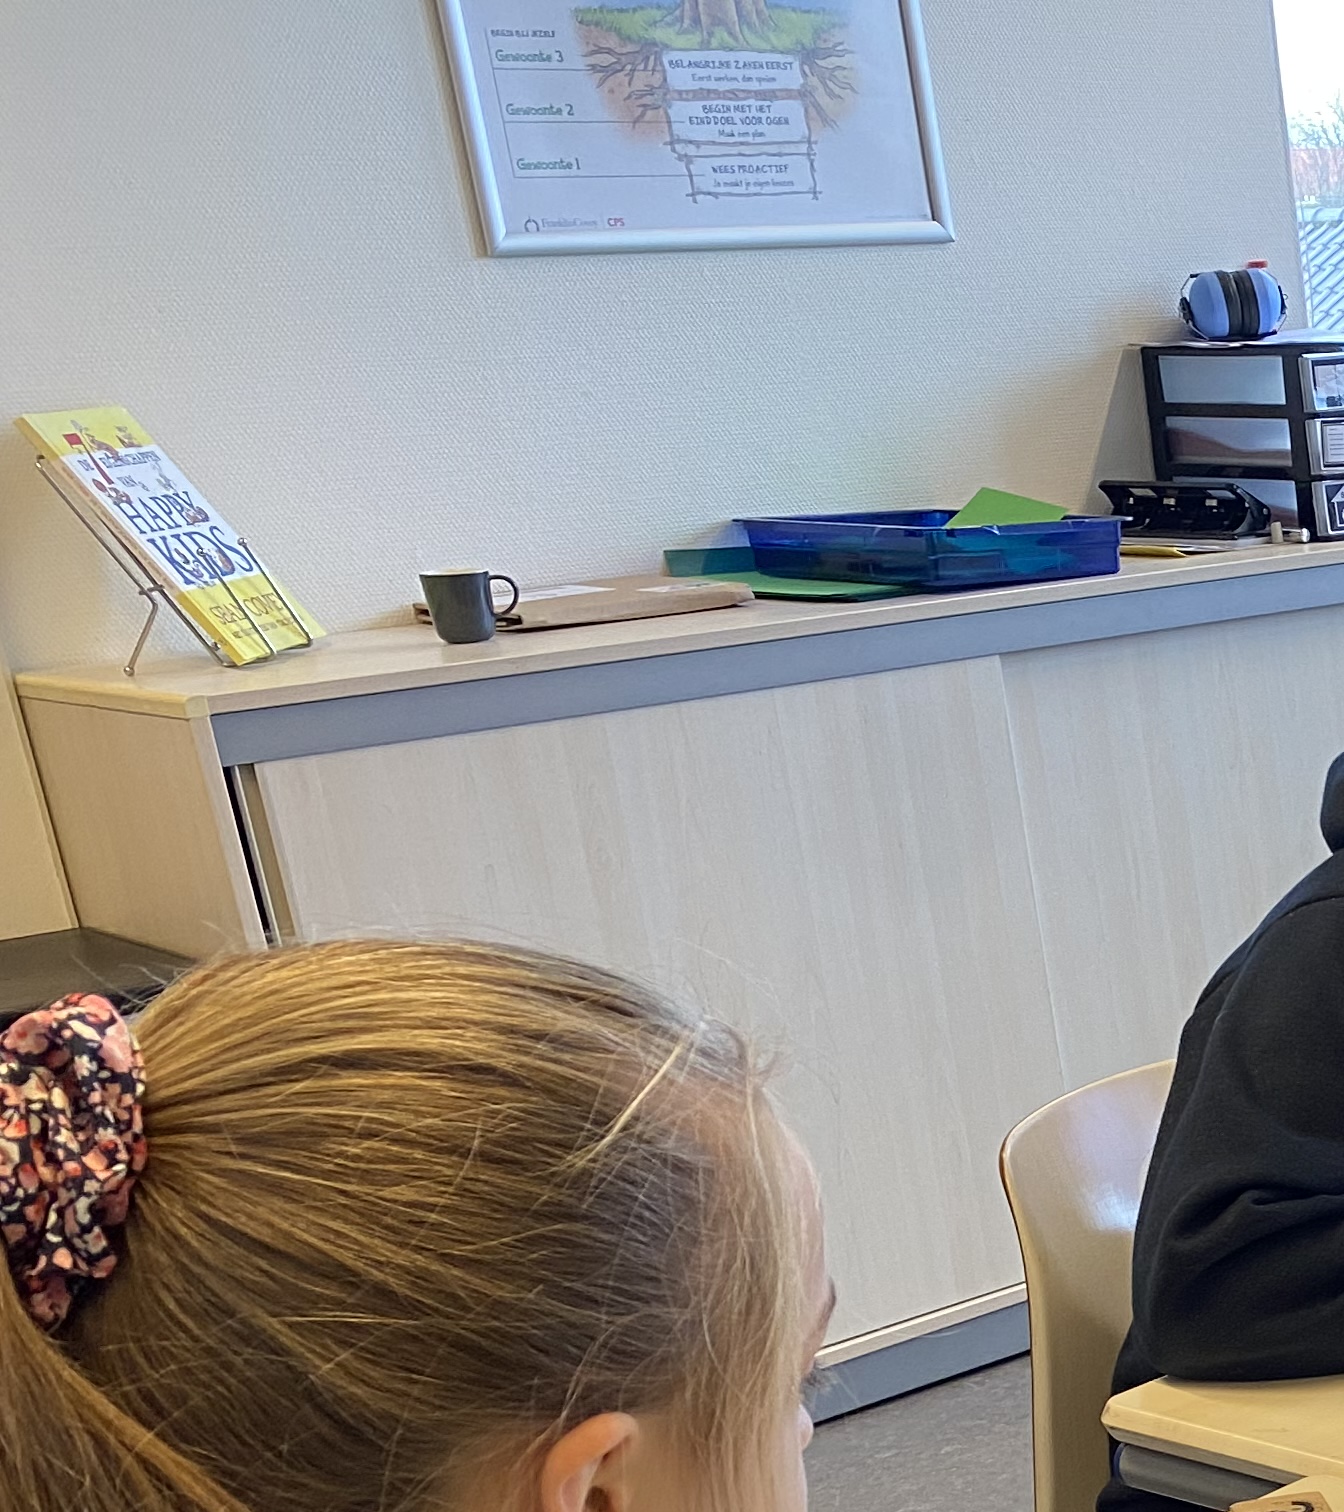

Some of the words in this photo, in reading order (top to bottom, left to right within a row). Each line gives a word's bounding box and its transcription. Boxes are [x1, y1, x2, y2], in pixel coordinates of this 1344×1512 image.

[495, 49, 551, 62] Gewoonte
[554, 50, 564, 63] 3
[766, 61, 793, 71] EERST
[505, 103, 563, 116] Gewoonte
[564, 104, 575, 116] 2
[701, 104, 731, 113] BEGIN
[733, 104, 752, 113] MET
[755, 104, 772, 113] HET
[739, 116, 764, 125] VOOR
[765, 116, 790, 125] OGEN
[516, 158, 574, 171] Gewoonte
[574, 157, 581, 170] 1
[711, 165, 736, 174] WEES
[737, 164, 789, 174] PROACTIEF
[607, 217, 625, 227] CPS
[113, 491, 200, 534] HAPPY
[146, 526, 254, 585] KIDS
